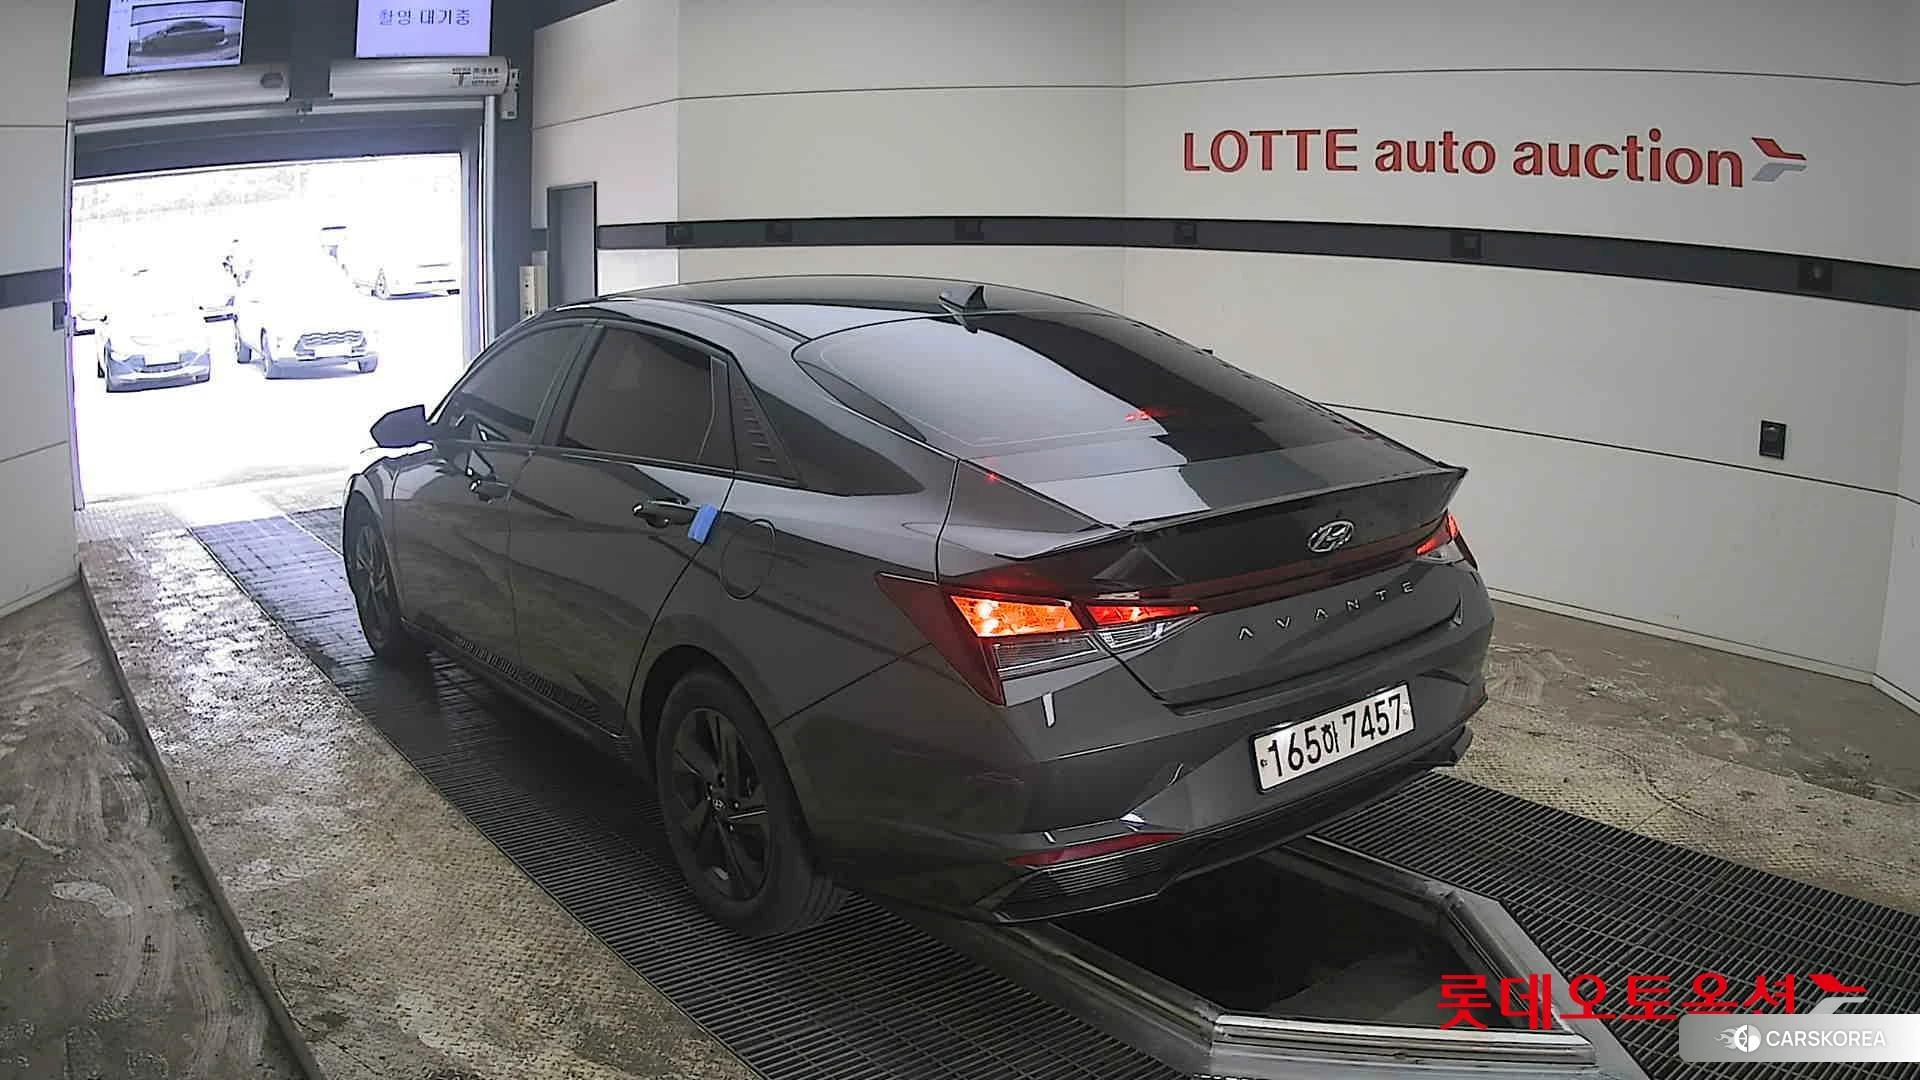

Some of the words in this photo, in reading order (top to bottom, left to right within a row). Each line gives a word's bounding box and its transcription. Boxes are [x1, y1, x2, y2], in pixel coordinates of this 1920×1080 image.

[419, 8, 470, 26] 대기중
[1184, 128, 1358, 173] LOTTE
[1374, 130, 1496, 174] auto
[1512, 128, 1744, 188] auction
[1238, 580, 1414, 641] AVANTE
[1267, 720, 1340, 777] 165하
[1342, 693, 1402, 748] 7457
